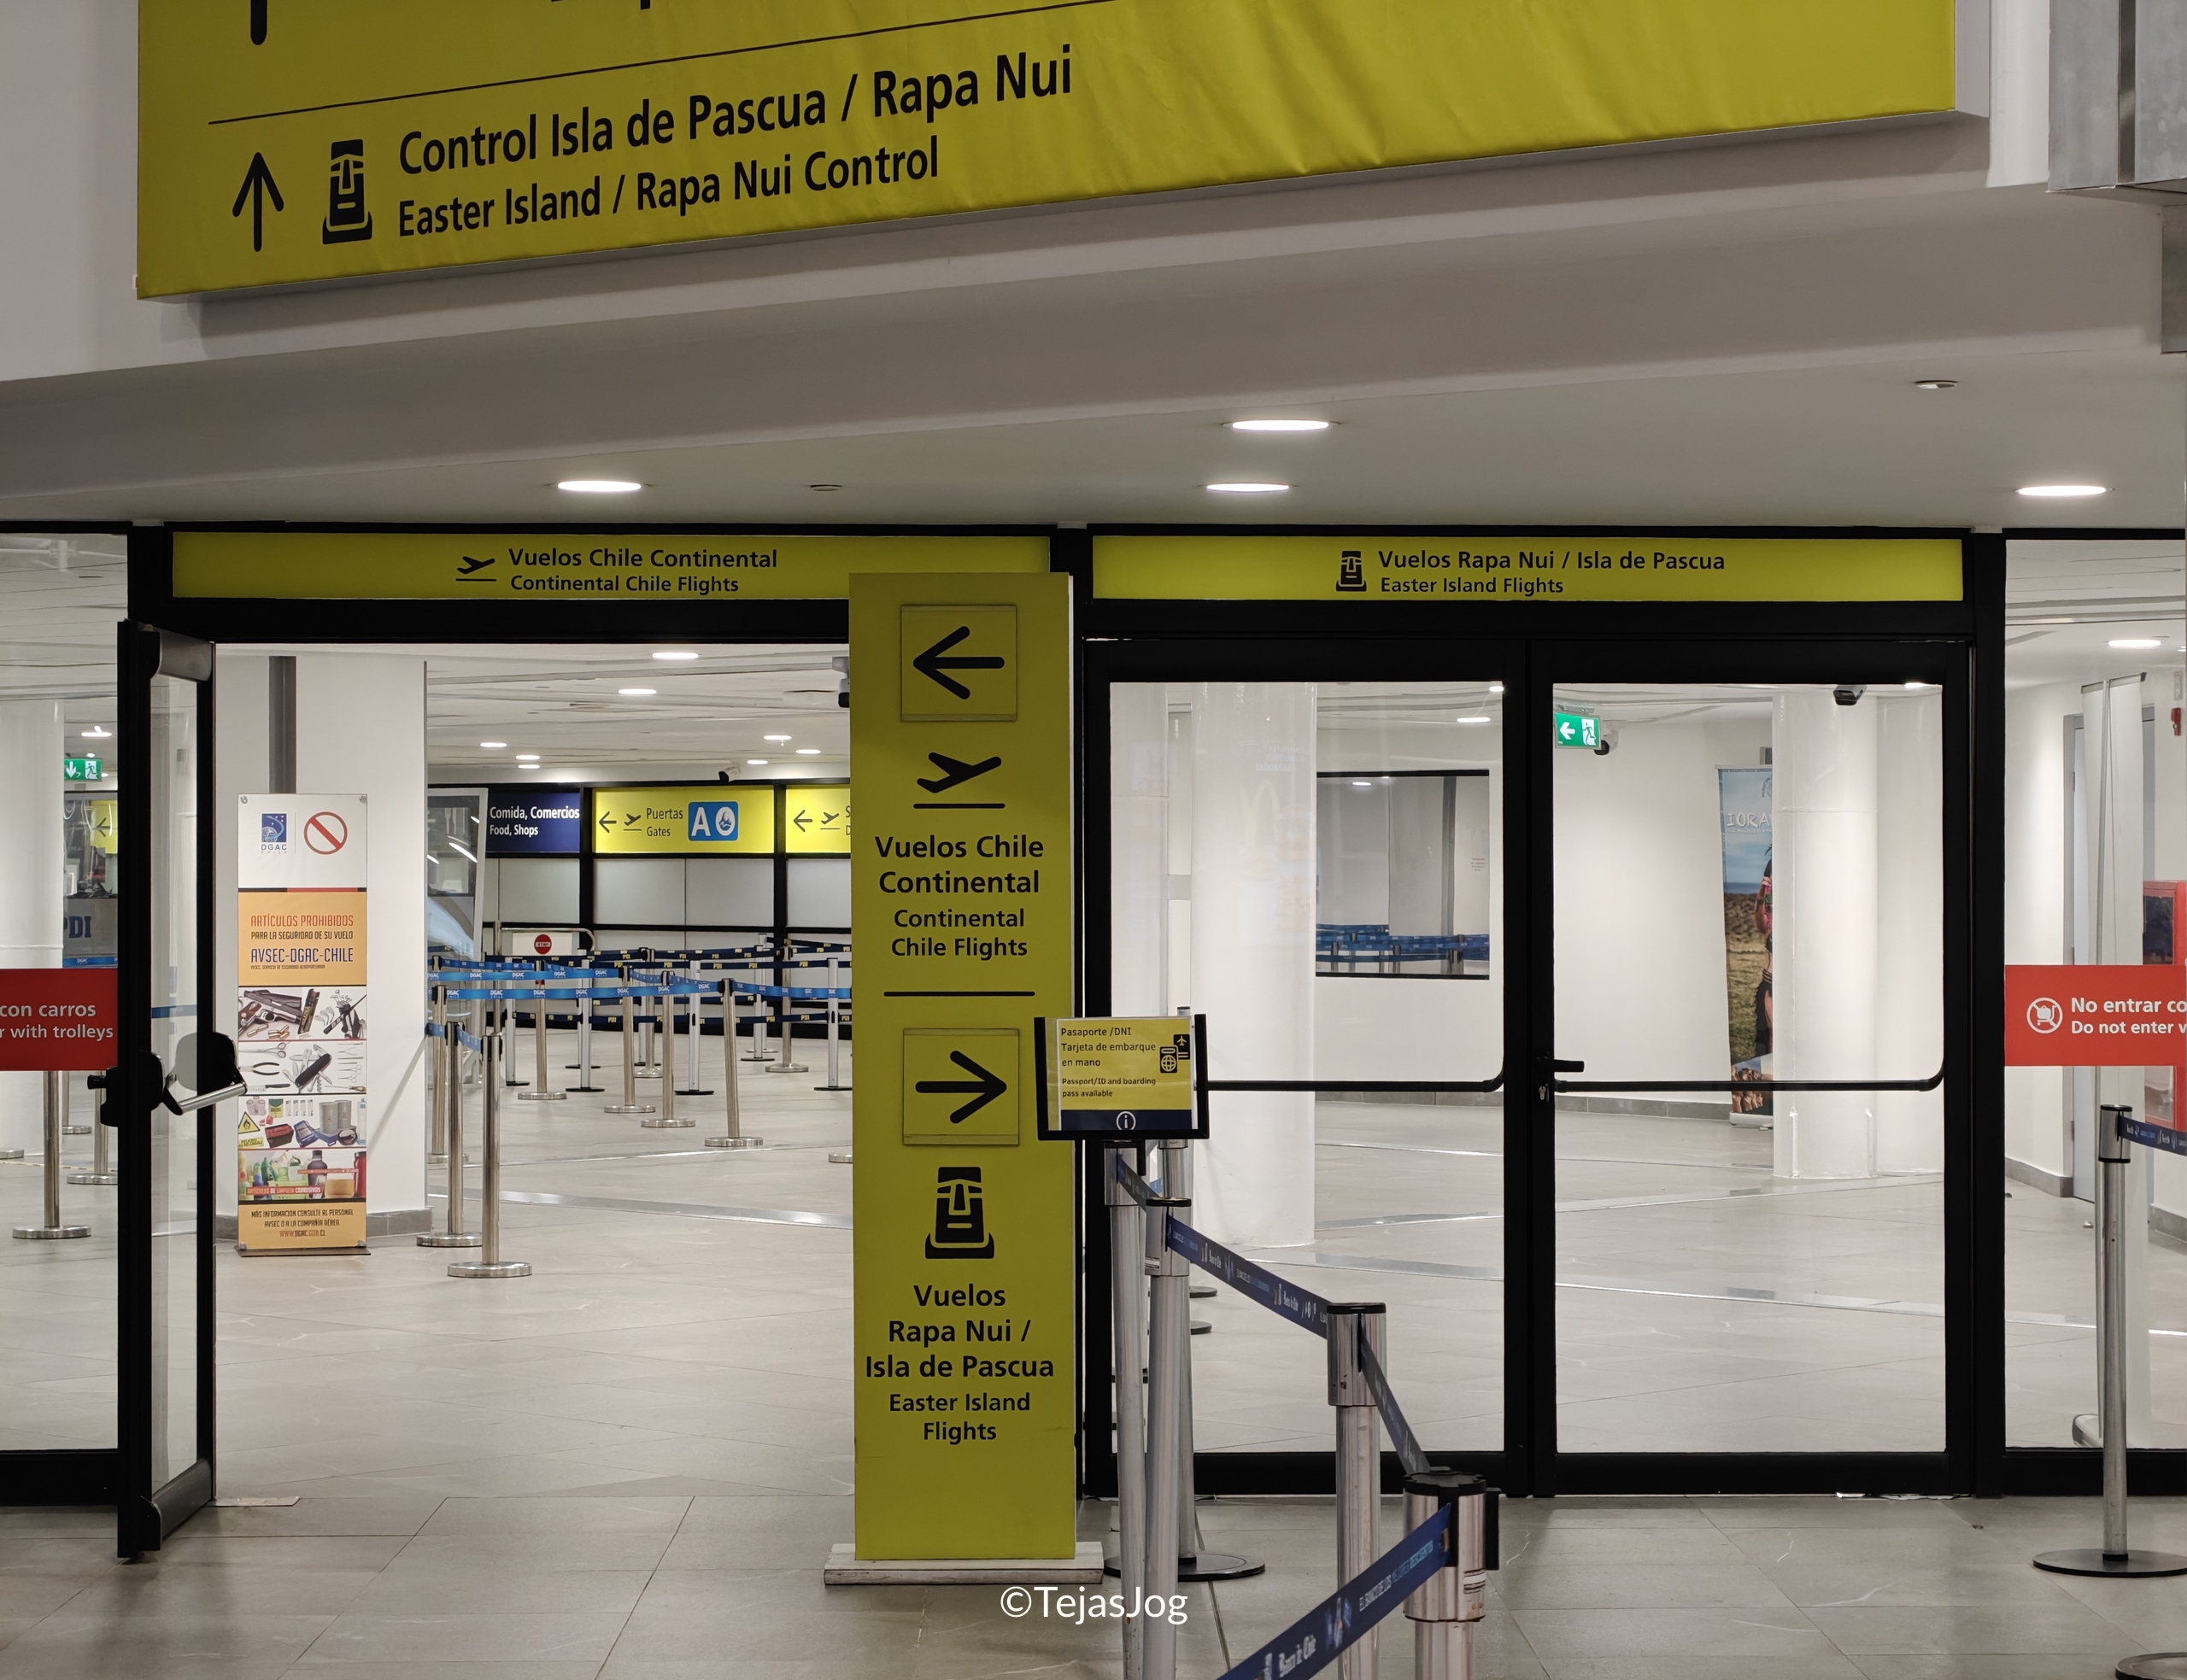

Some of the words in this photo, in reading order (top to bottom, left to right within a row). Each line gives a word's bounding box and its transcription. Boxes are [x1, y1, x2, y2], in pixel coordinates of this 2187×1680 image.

[399, 114, 536, 174] Control
[552, 106, 613, 157] Isla
[626, 98, 675, 148] de
[689, 90, 826, 140] Pascua
[841, 73, 859, 122] /
[873, 70, 979, 124] Rapa
[996, 44, 1071, 102] Nui
[399, 196, 495, 237] Easter
[505, 175, 601, 225] Island
[612, 174, 626, 214] /
[636, 172, 721, 217] Rapa
[734, 153, 791, 201] Nui
[804, 135, 939, 192] Control
[507, 547, 583, 567] Vuelos
[589, 547, 644, 568] Chile
[649, 548, 777, 569] Continental
[1377, 550, 1451, 569] Vuelos
[1457, 551, 1511, 573] Rapa
[1518, 550, 1555, 570] Nui
[1561, 551, 1570, 570] /
[1577, 550, 1612, 570] Isla
[1620, 550, 1646, 570] de
[1652, 552, 1726, 571] Pascua
[510, 575, 620, 592] Continental
[625, 575, 672, 593] Chile
[677, 576, 740, 596] Flights
[1381, 577, 1438, 594] Easter
[1442, 577, 1497, 594] Island
[1502, 577, 1564, 598] Flights
[490, 805, 528, 821] Comida,
[530, 805, 580, 819] Comercios
[646, 807, 683, 821] Puertas
[690, 806, 712, 837] A
[1727, 812, 1773, 828] IORA
[490, 824, 513, 837] Food,
[513, 824, 539, 837] Shops
[646, 826, 671, 838] Gates
[874, 834, 968, 858] Vuelos
[976, 834, 1044, 858] Chile
[878, 869, 1040, 893] Continental
[250, 913, 298, 928] ARTÍCULOS
[300, 915, 354, 927] PROHIBIDOS
[894, 908, 1025, 928] Continental
[250, 931, 268, 940] PARA
[269, 931, 277, 940] LA
[278, 931, 314, 940] SEGURIDAD
[314, 931, 323, 940] DE
[324, 930, 332, 940] SU
[333, 930, 354, 940] VUELO
[250, 947, 354, 963] AVSEC-DGAC-CHILE
[891, 937, 947, 957] Chile
[954, 937, 1028, 962] Flights
[38, 1004, 97, 1017] carros
[2071, 997, 2098, 1013] No
[2103, 998, 2162, 1013] entrar
[9, 1024, 48, 1039] with
[52, 1023, 114, 1042] trolleys
[1060, 1027, 1108, 1038] Pasaporte
[1109, 1027, 1132, 1037] /DNI
[2071, 1020, 2094, 1034] Do
[2099, 1021, 2127, 1034] not
[2131, 1021, 2174, 1034] enter
[1061, 1043, 1094, 1053] Tarjeta
[1095, 1042, 1108, 1051] de
[1109, 1042, 1157, 1053] embarque
[1062, 1078, 1106, 1086] Passport/ID
[1123, 1077, 1157, 1086] boarding
[1062, 1090, 1080, 1098] pass
[1080, 1089, 1113, 1098] available
[262, 1209, 296, 1218] INFORMACIÓN
[296, 1209, 322, 1217] CONSULTE
[912, 1283, 1006, 1307] Vuelos
[888, 1320, 956, 1349] Rapa
[965, 1319, 1011, 1343] Nui
[1020, 1319, 1032, 1343] /
[865, 1354, 910, 1378] Isla
[918, 1354, 953, 1378] de
[962, 1355, 1054, 1378] Pascua
[889, 1393, 959, 1412] Easter
[965, 1391, 1031, 1412] Island
[923, 1420, 998, 1446] Flights
